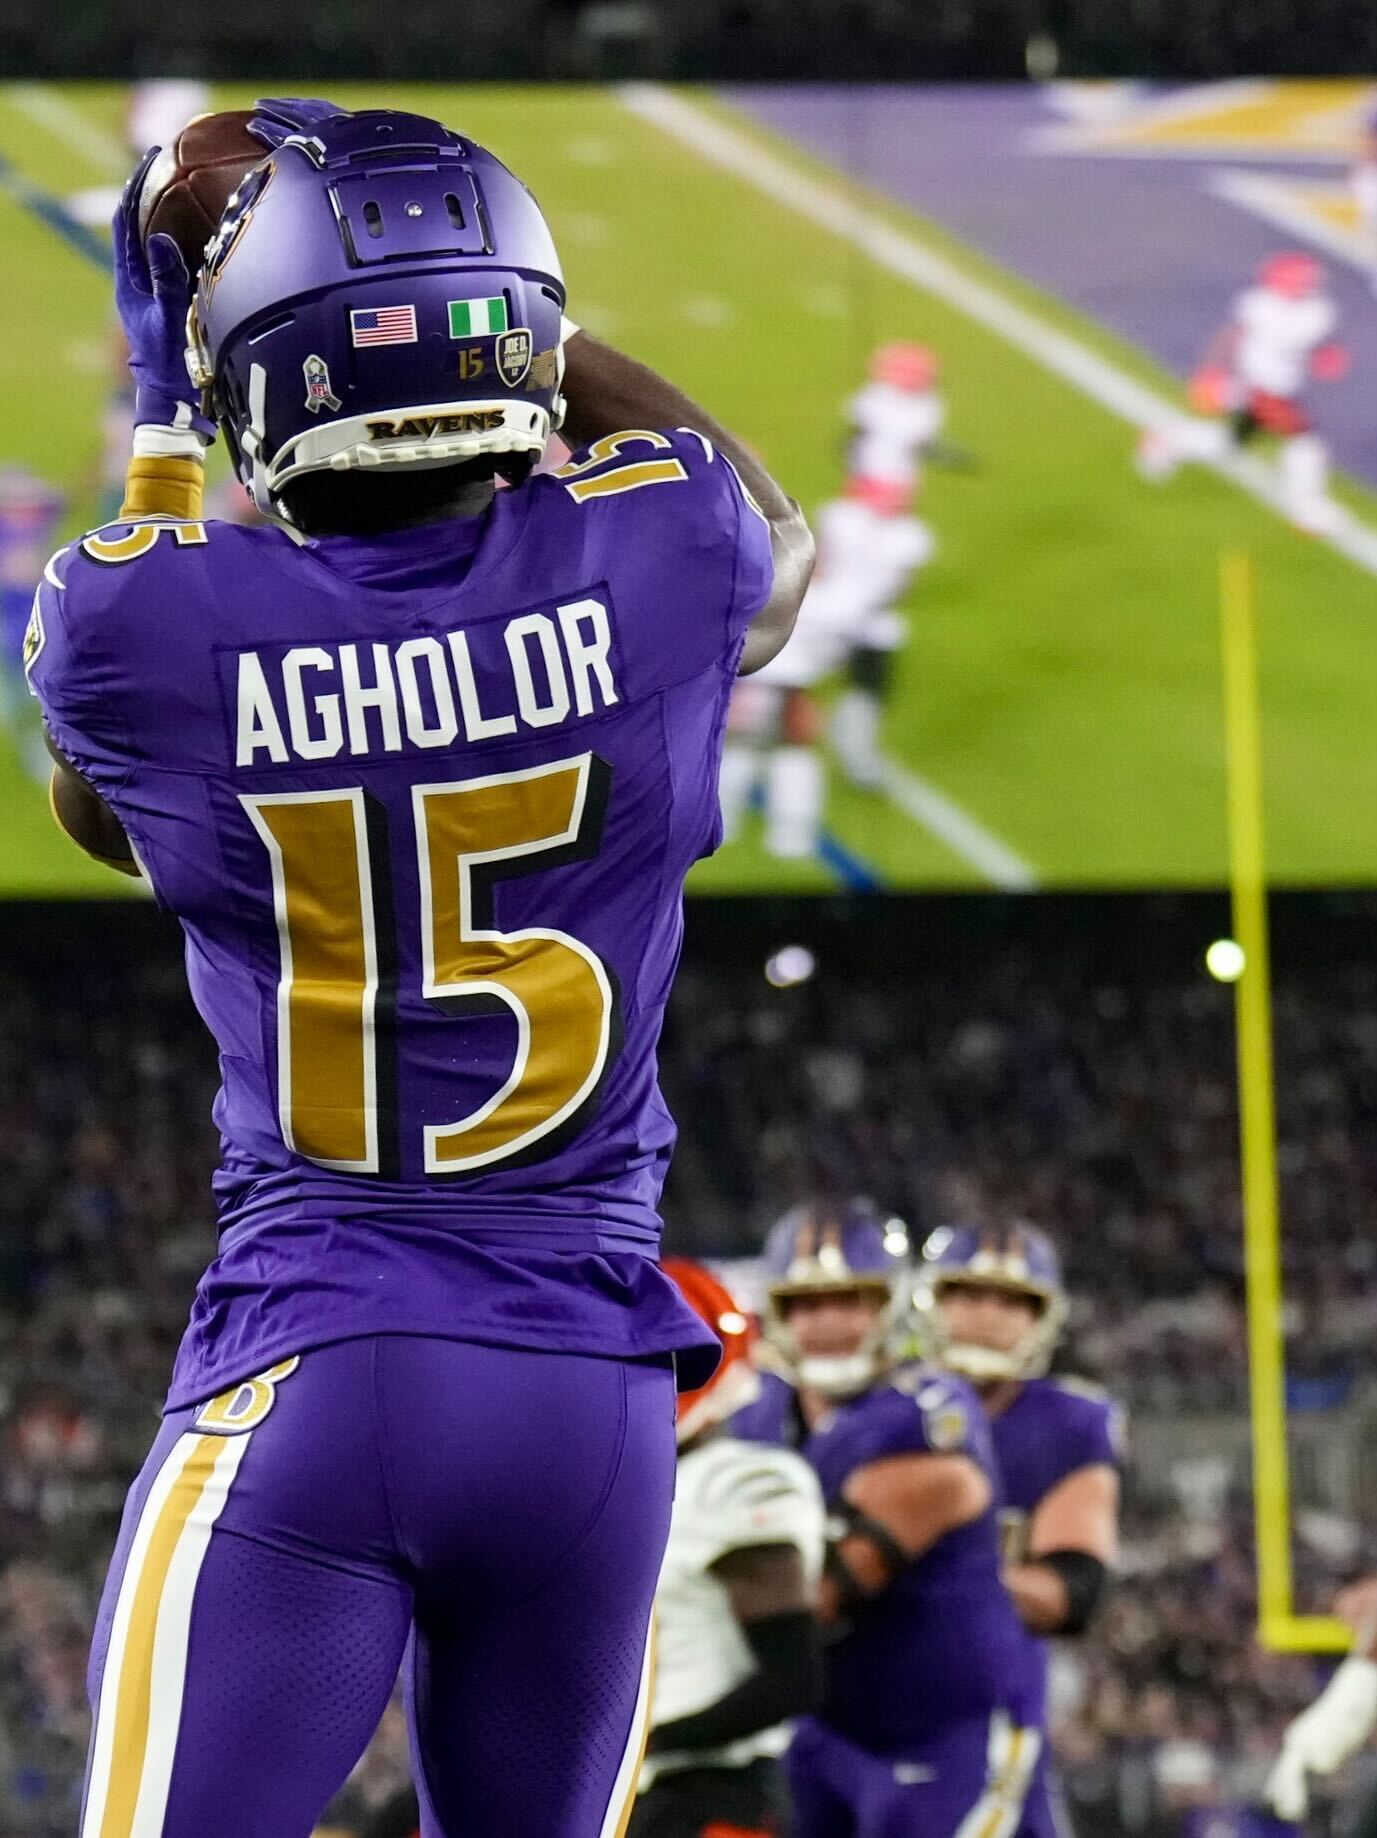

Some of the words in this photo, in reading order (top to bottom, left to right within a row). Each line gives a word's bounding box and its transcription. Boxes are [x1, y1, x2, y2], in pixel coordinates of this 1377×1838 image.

[458, 347, 484, 379] 15
[365, 408, 505, 441] RAVENS
[83, 515, 209, 564] 5
[236, 598, 619, 767] AGHOLOR
[237, 750, 616, 1176] 15
